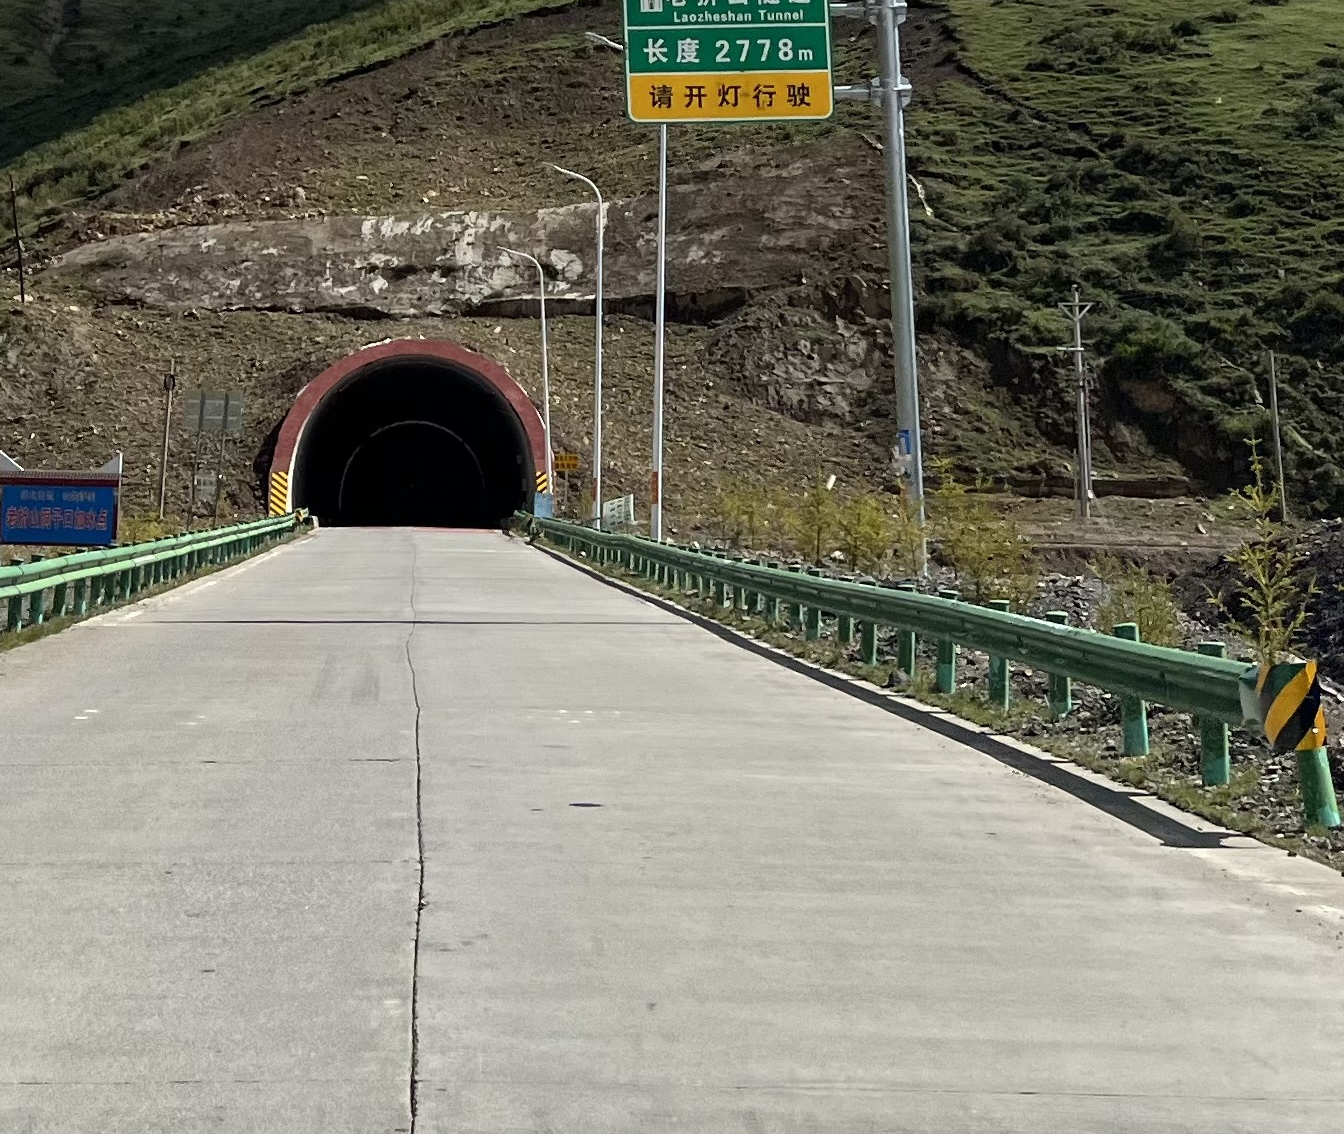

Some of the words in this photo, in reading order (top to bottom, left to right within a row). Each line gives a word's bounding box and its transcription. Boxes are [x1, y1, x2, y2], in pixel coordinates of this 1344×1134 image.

[673, 11, 752, 23] Laozheshan
[759, 9, 804, 21] Tunnel
[643, 38, 700, 64] 长度
[715, 38, 813, 63] 2778m
[649, 83, 811, 109] 请开灯行驶
